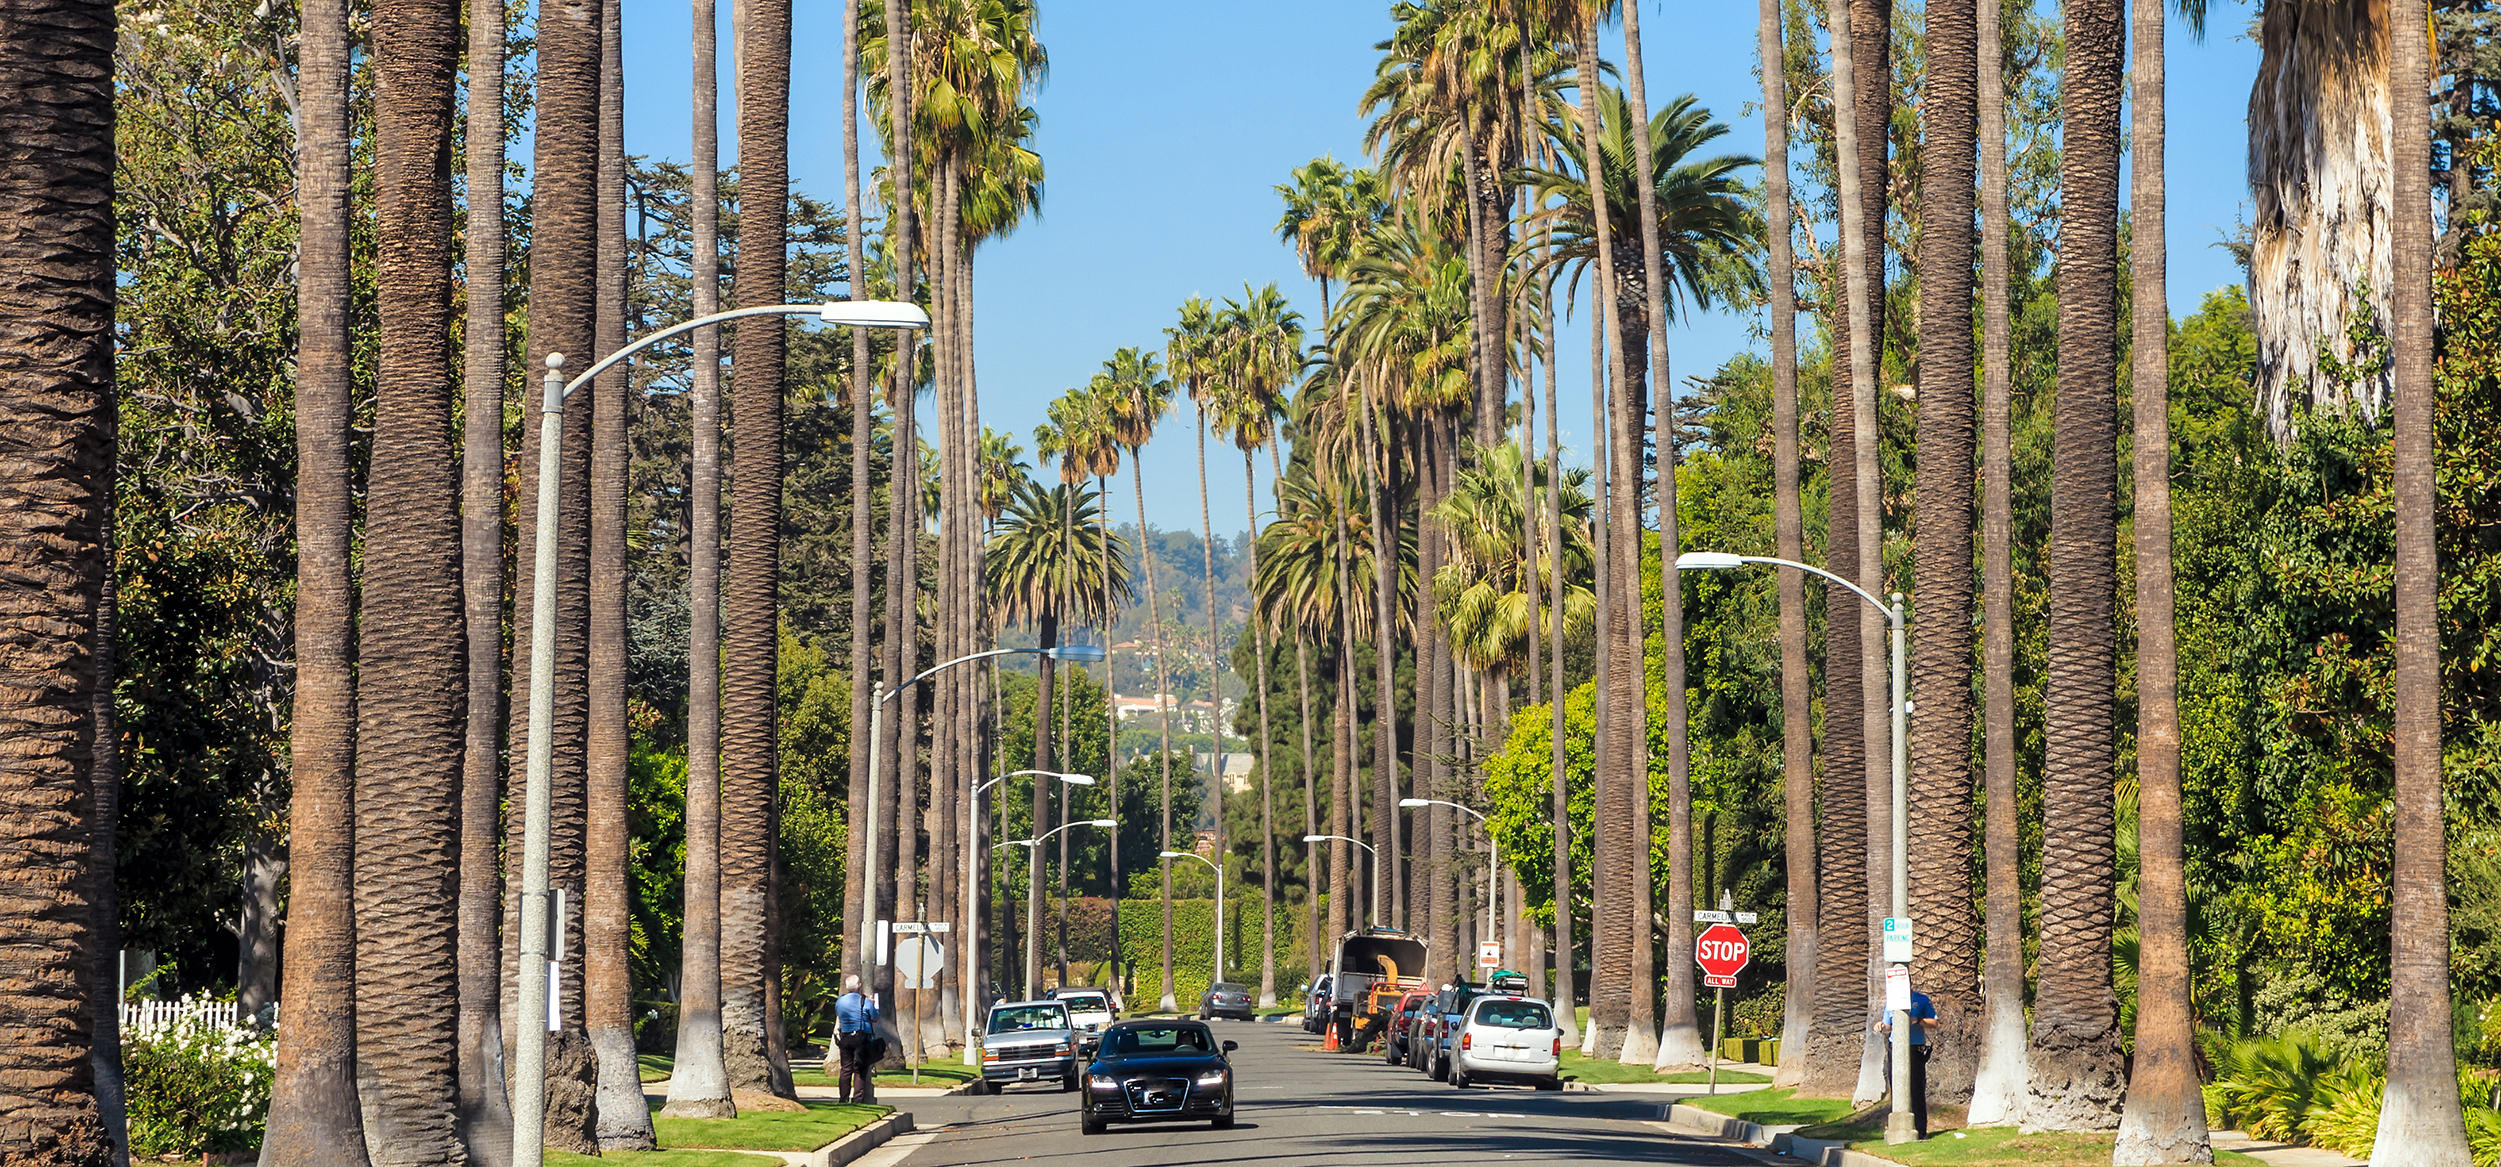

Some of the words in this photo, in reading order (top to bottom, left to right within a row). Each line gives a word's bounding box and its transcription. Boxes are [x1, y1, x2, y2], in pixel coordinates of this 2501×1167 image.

[1698, 912, 1735, 921] CARMELITA
[1886, 921, 1893, 930] 2
[1700, 940, 1745, 961] STOP
[1707, 977, 1719, 985] ALL
